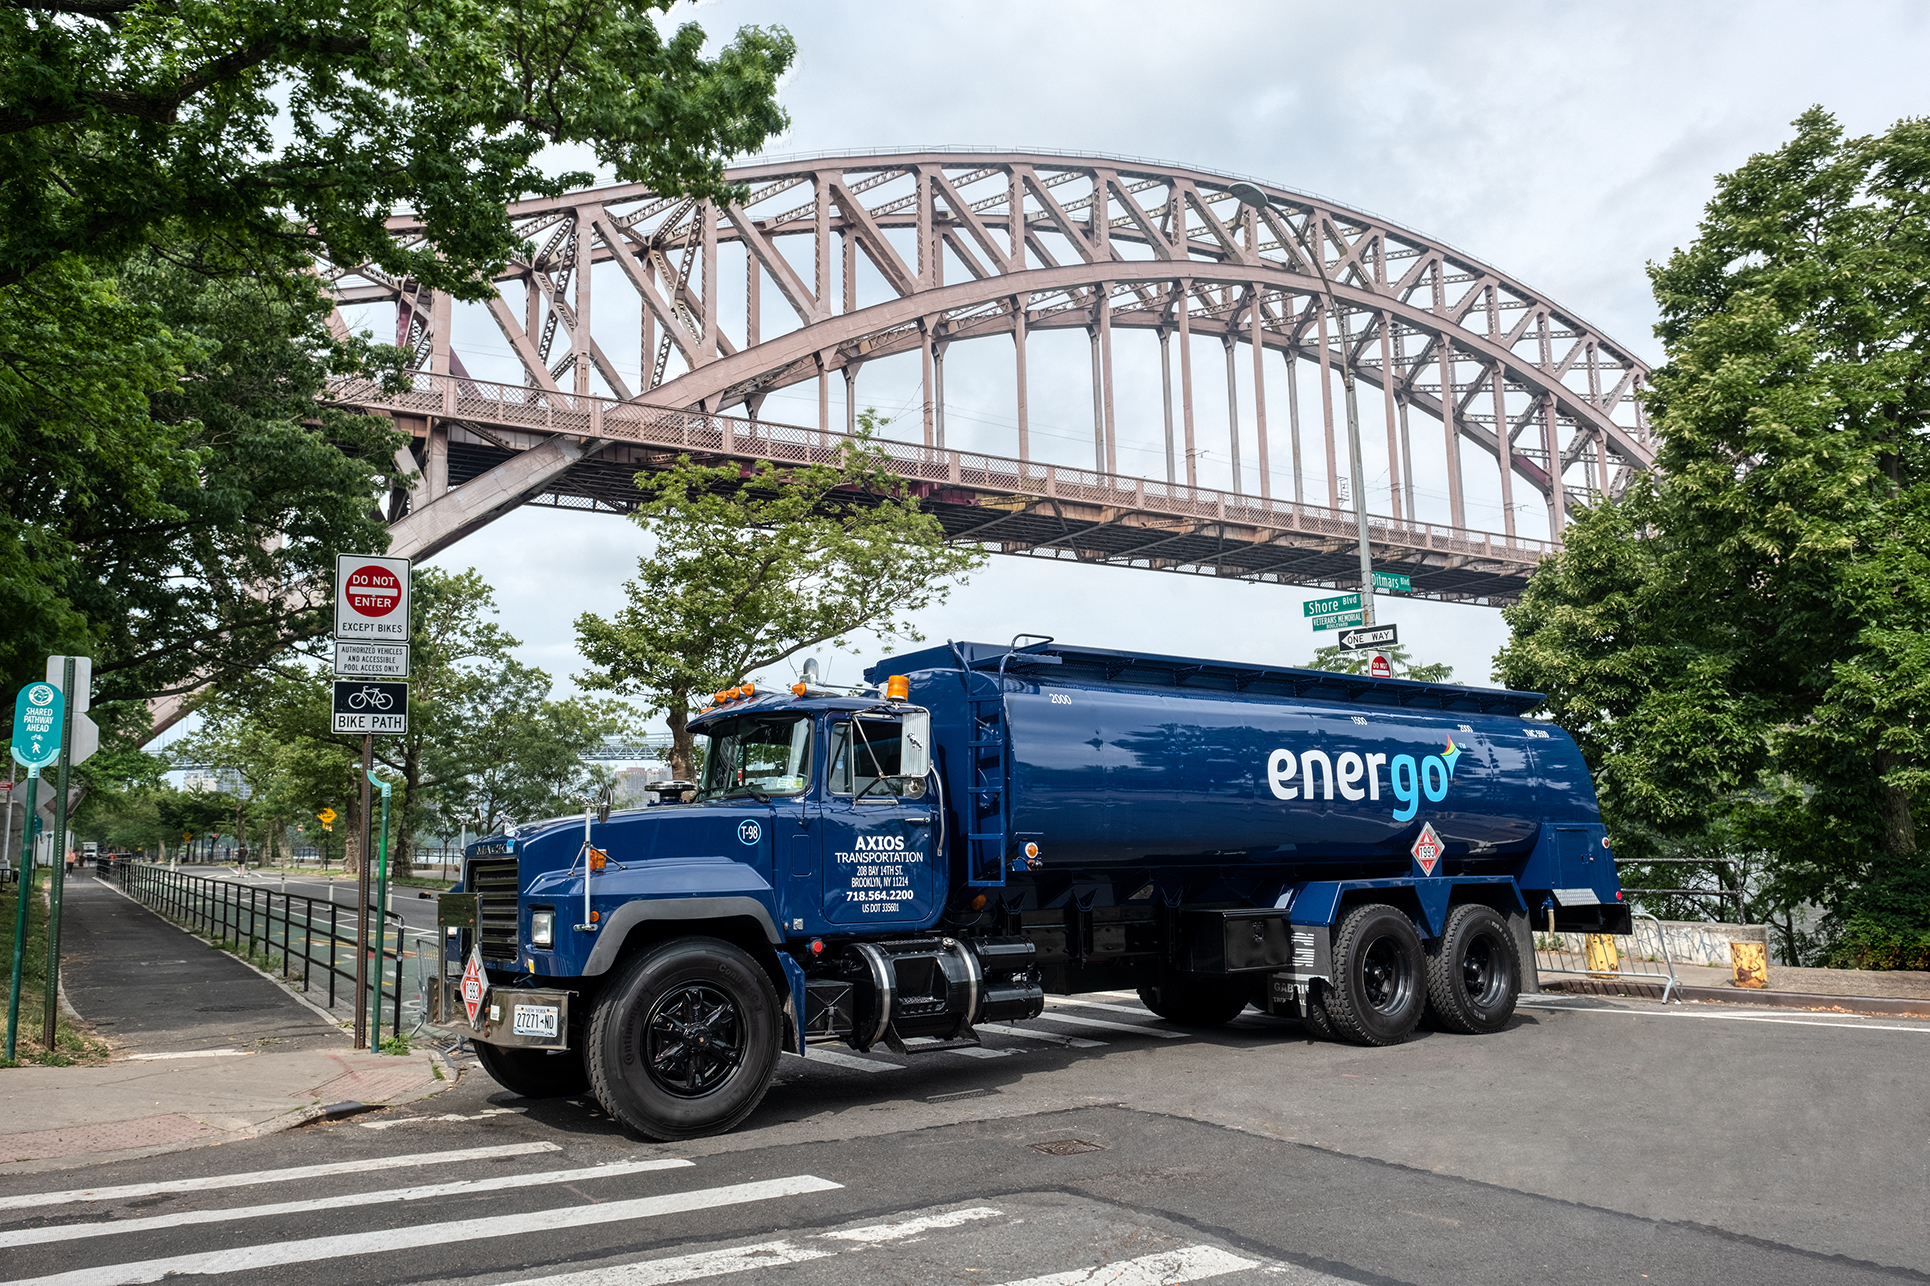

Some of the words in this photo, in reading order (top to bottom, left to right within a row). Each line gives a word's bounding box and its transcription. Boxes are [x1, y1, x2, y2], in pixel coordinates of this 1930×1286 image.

[352, 575, 368, 584] DO
[373, 576, 395, 586] NOT
[1372, 573, 1399, 588] Ditmars
[1400, 577, 1410, 585] Blvd
[355, 597, 391, 608] ENTER
[1309, 600, 1338, 614] Shore
[1342, 596, 1357, 605] Blvd
[1313, 616, 1337, 626] VETERANS
[1338, 613, 1361, 623] MEMORIAL
[342, 623, 374, 631] EXCEPT
[378, 624, 402, 633] BIKES
[1347, 635, 1364, 644] ONE
[1372, 631, 1390, 641] WAY
[341, 646, 375, 654] AUTHORIZED
[1049, 693, 1071, 705] 2000
[26, 707, 53, 716] SHARED
[23, 716, 54, 724] PATHWAY
[338, 716, 365, 728] BIKE
[372, 716, 402, 728] PATH
[1351, 716, 1367, 725] 1500
[26, 724, 49, 732] AHEAD
[1267, 749, 1449, 822] energo
[741, 826, 758, 840] T-98
[855, 836, 904, 851] AXIOS
[1420, 846, 1435, 857] 1993
[835, 852, 923, 863] TRANSPORTATION
[856, 866, 867, 876] 208
[868, 866, 879, 875] BAY
[880, 865, 894, 875] 14TH
[895, 865, 903, 875] ST.
[851, 877, 882, 889] BROOKLYN,
[884, 877, 891, 886] NY
[893, 876, 908, 886] 11214
[846, 890, 913, 901] 718.564.2200
[862, 904, 869, 913] US
[870, 904, 881, 912] DOT
[1273, 982, 1310, 994] GABRIE
